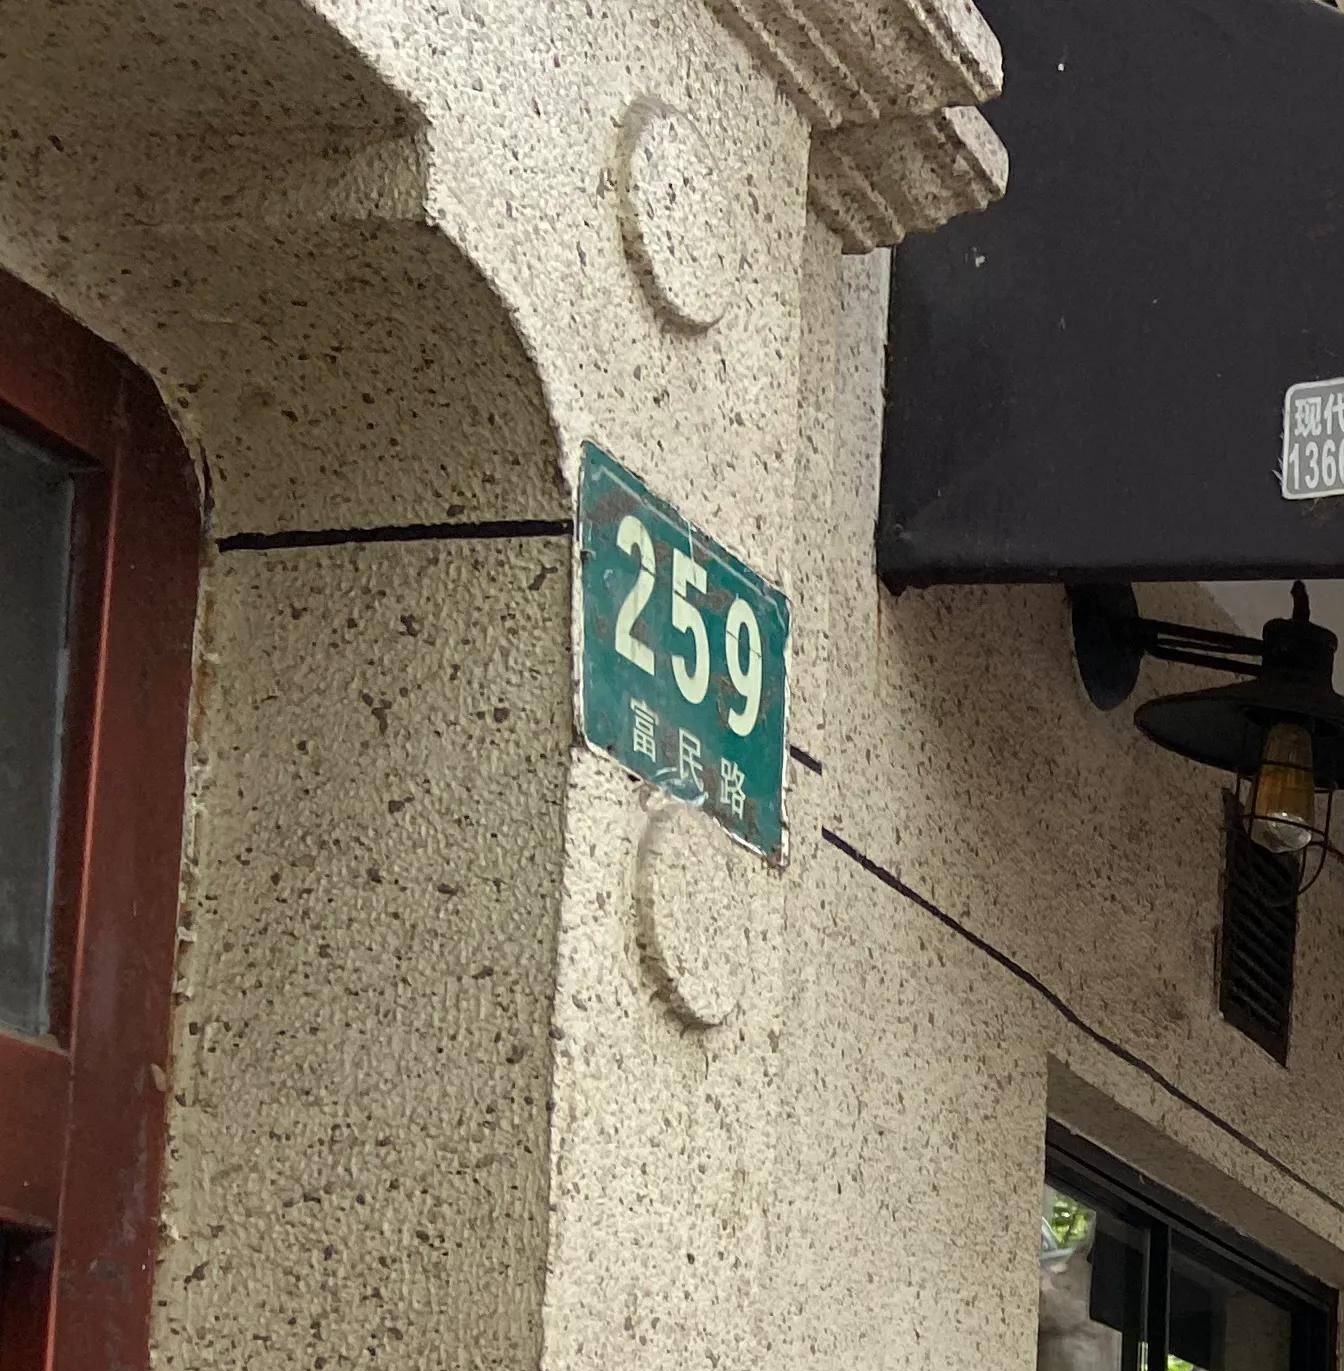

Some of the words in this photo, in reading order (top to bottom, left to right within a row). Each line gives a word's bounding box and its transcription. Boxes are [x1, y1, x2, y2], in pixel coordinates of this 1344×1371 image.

[614, 514, 764, 738] 259
[628, 697, 747, 821] 富民路
